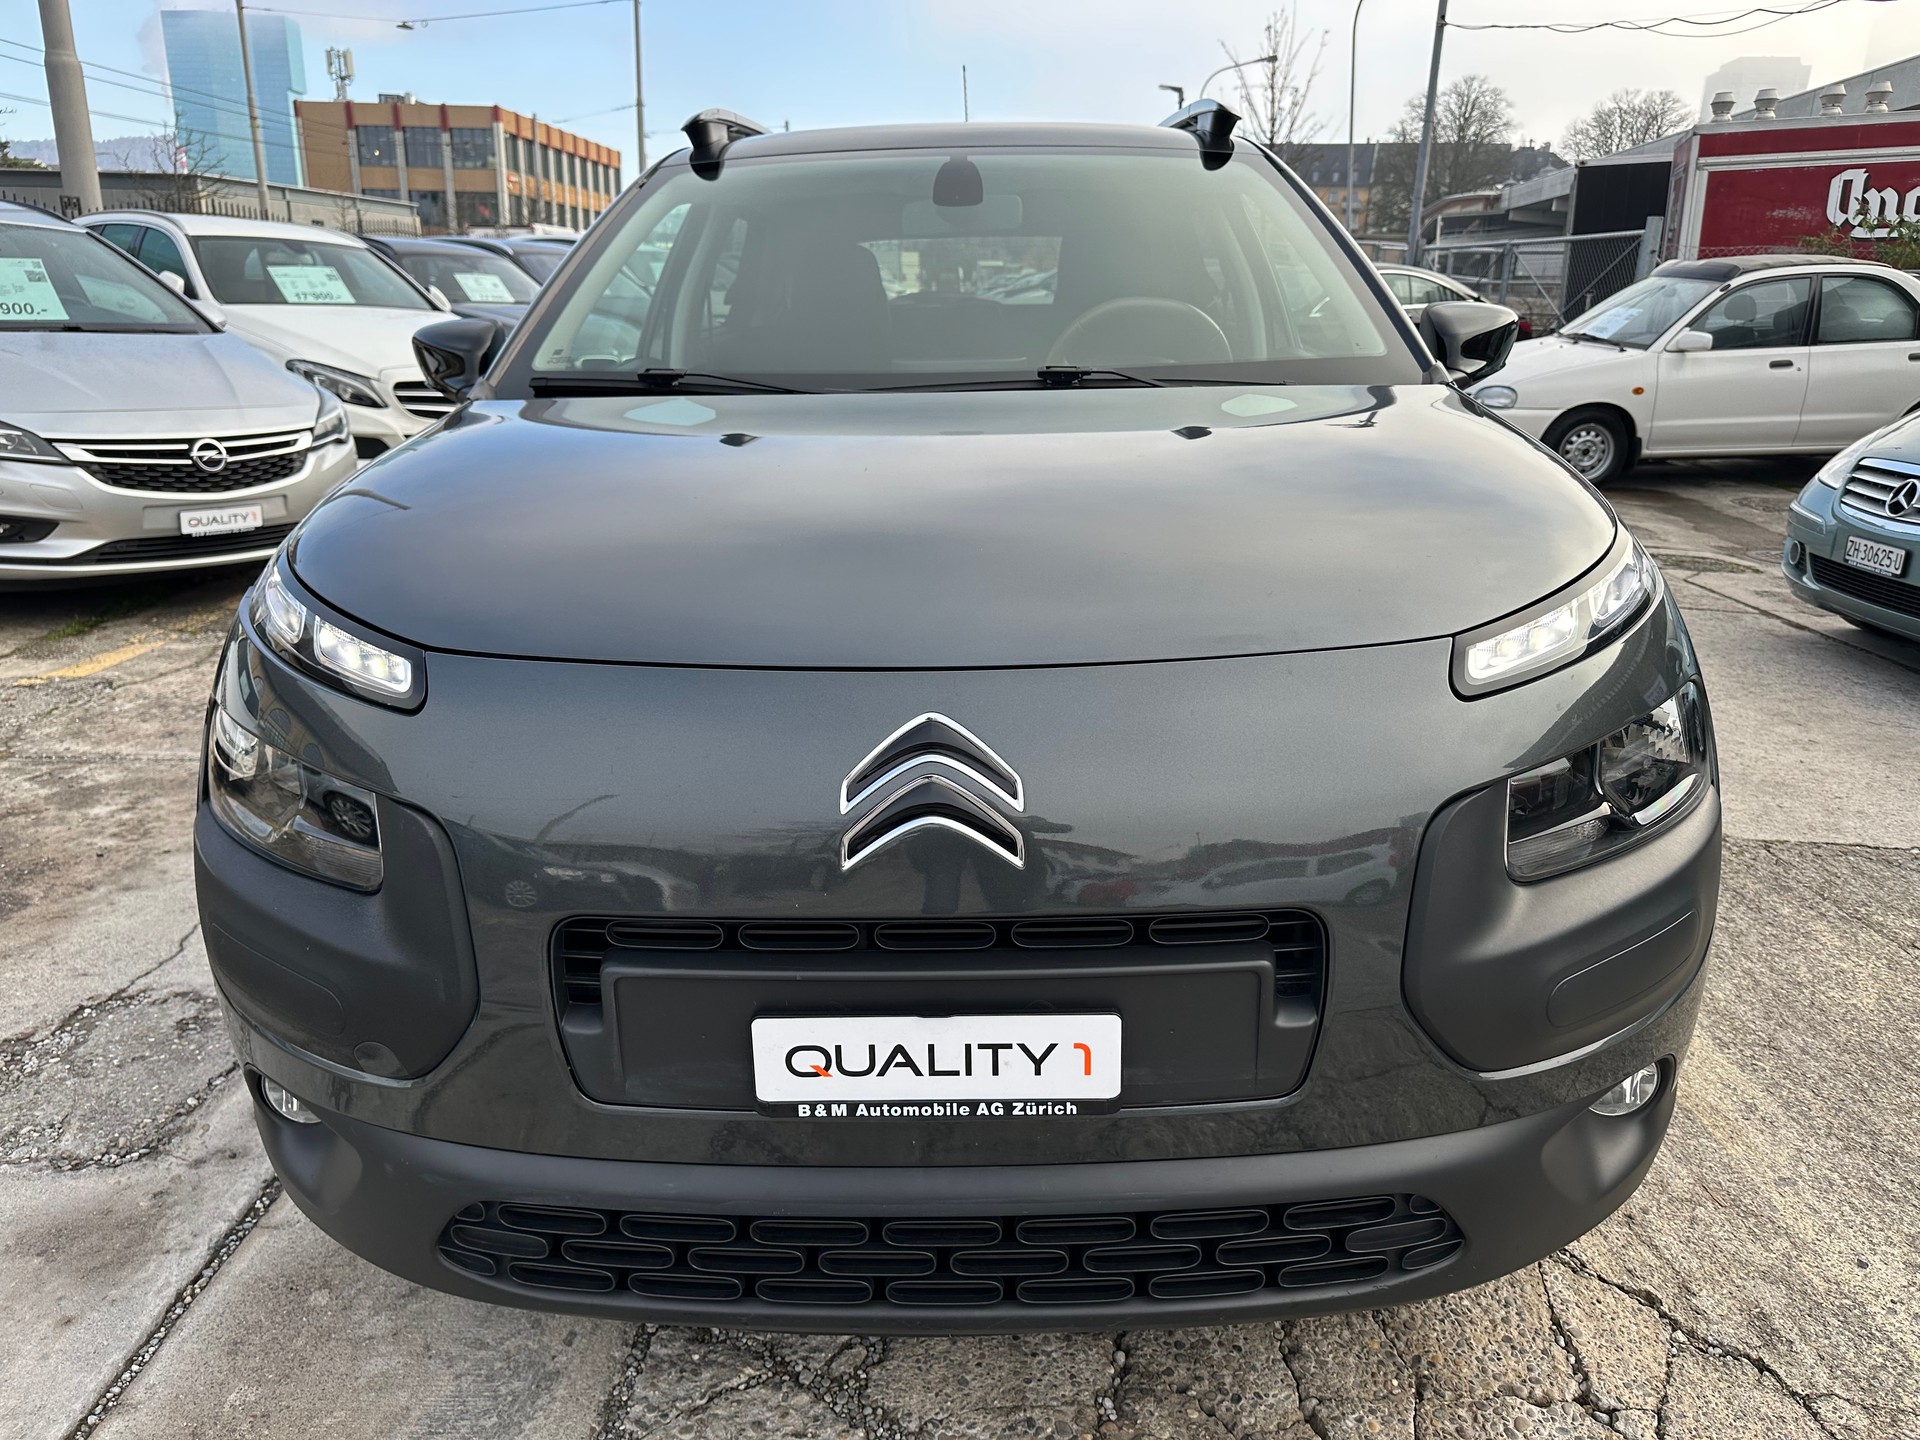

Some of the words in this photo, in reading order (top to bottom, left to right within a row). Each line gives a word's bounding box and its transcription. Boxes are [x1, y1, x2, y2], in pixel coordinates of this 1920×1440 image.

[188, 512, 249, 528] QUALITY
[251, 510, 257, 524] 1
[785, 1043, 1059, 1078] QUALITY
[1073, 1042, 1091, 1076] 1
[855, 1102, 970, 1117] Automobile
[976, 1102, 1004, 1116] AG
[1012, 1101, 1078, 1116] Zürich
